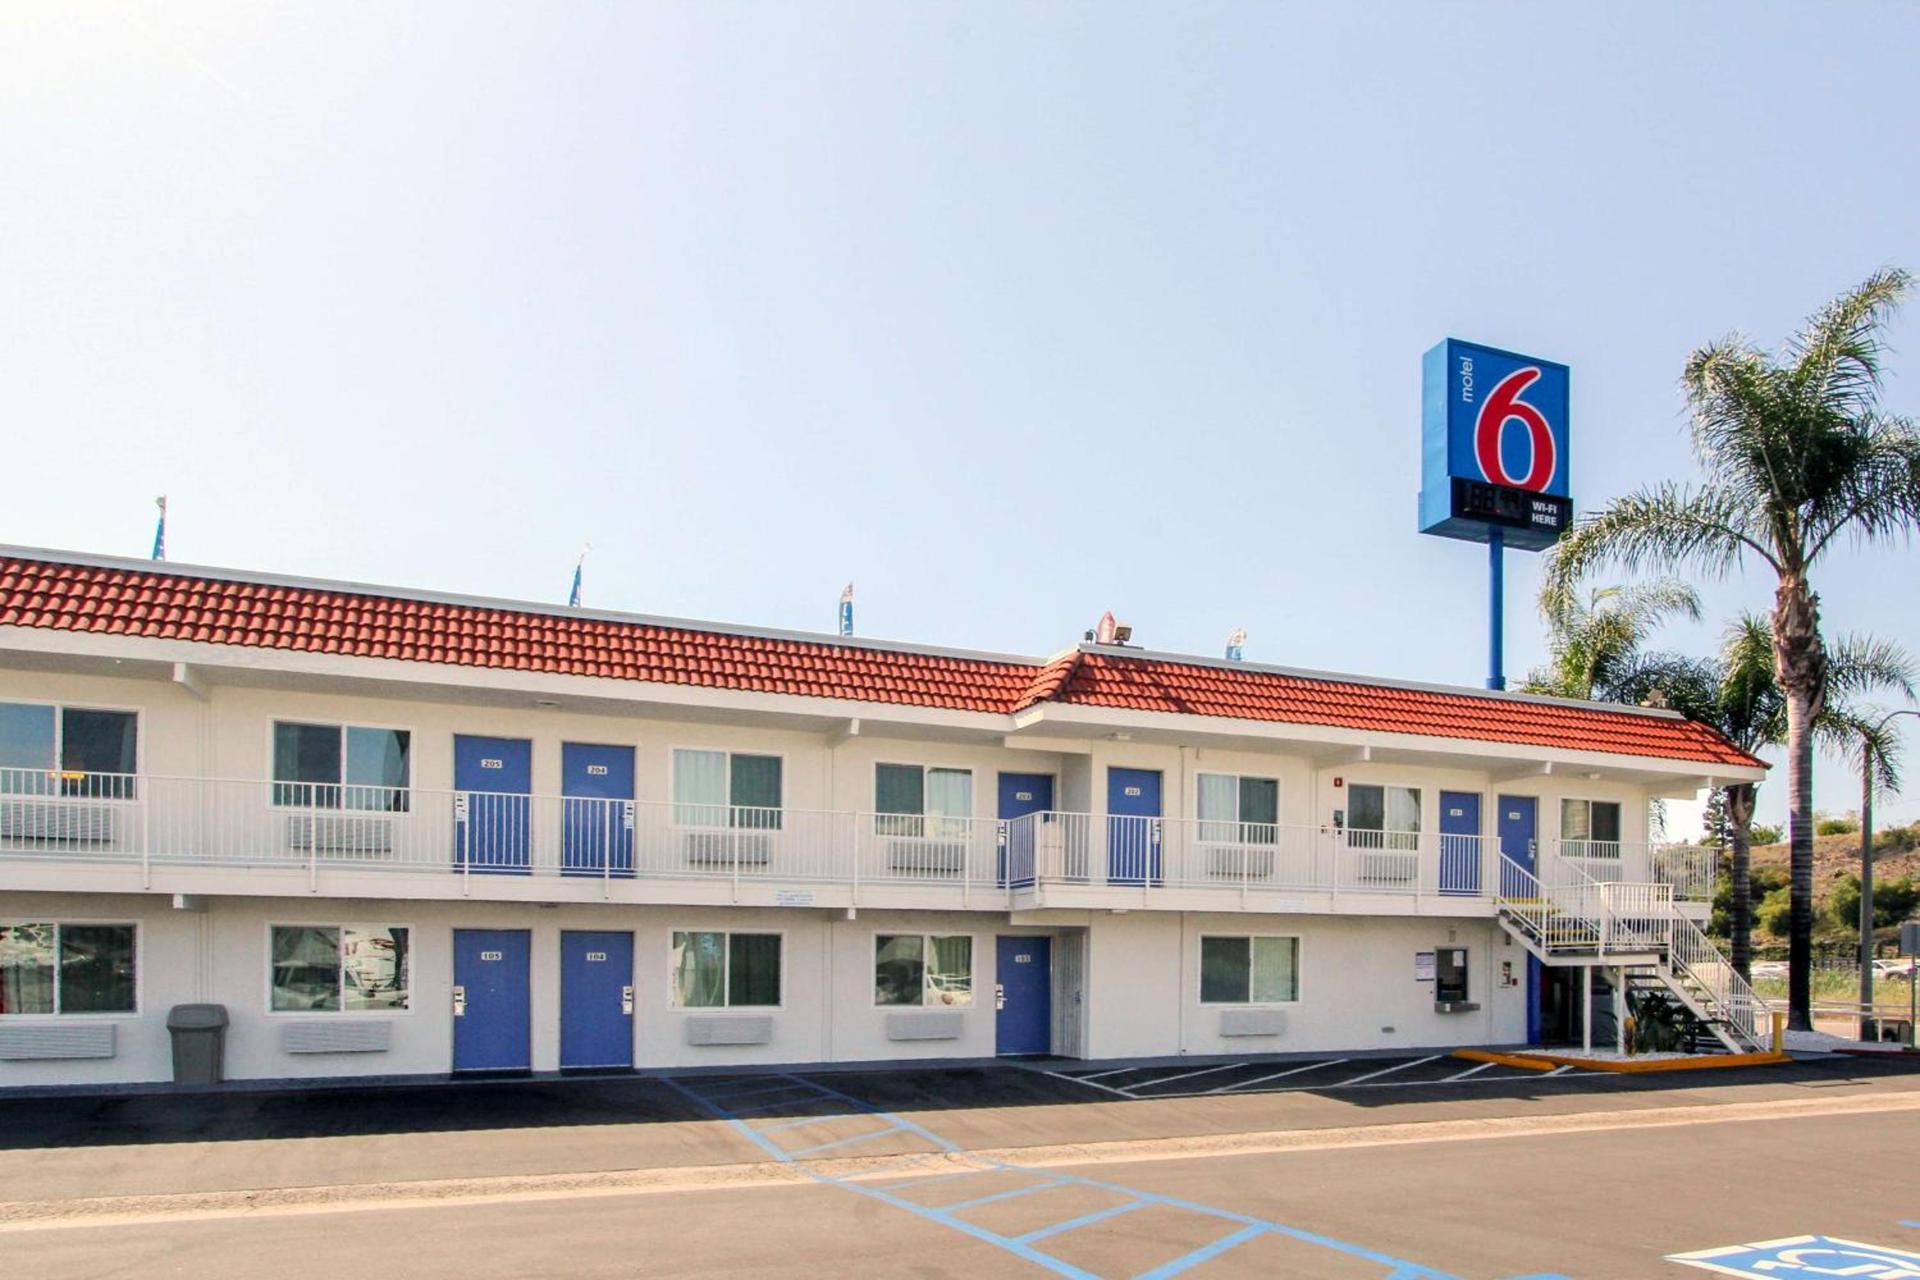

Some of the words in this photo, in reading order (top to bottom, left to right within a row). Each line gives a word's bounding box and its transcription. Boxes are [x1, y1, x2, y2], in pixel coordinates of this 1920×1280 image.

[1460, 356, 1473, 402] motel
[1474, 366, 1556, 493] 6
[1532, 501, 1557, 514] WI-FI
[1532, 513, 1557, 526] HERE
[483, 760, 501, 768] 205
[590, 766, 606, 774] 204
[483, 952, 501, 960] 105
